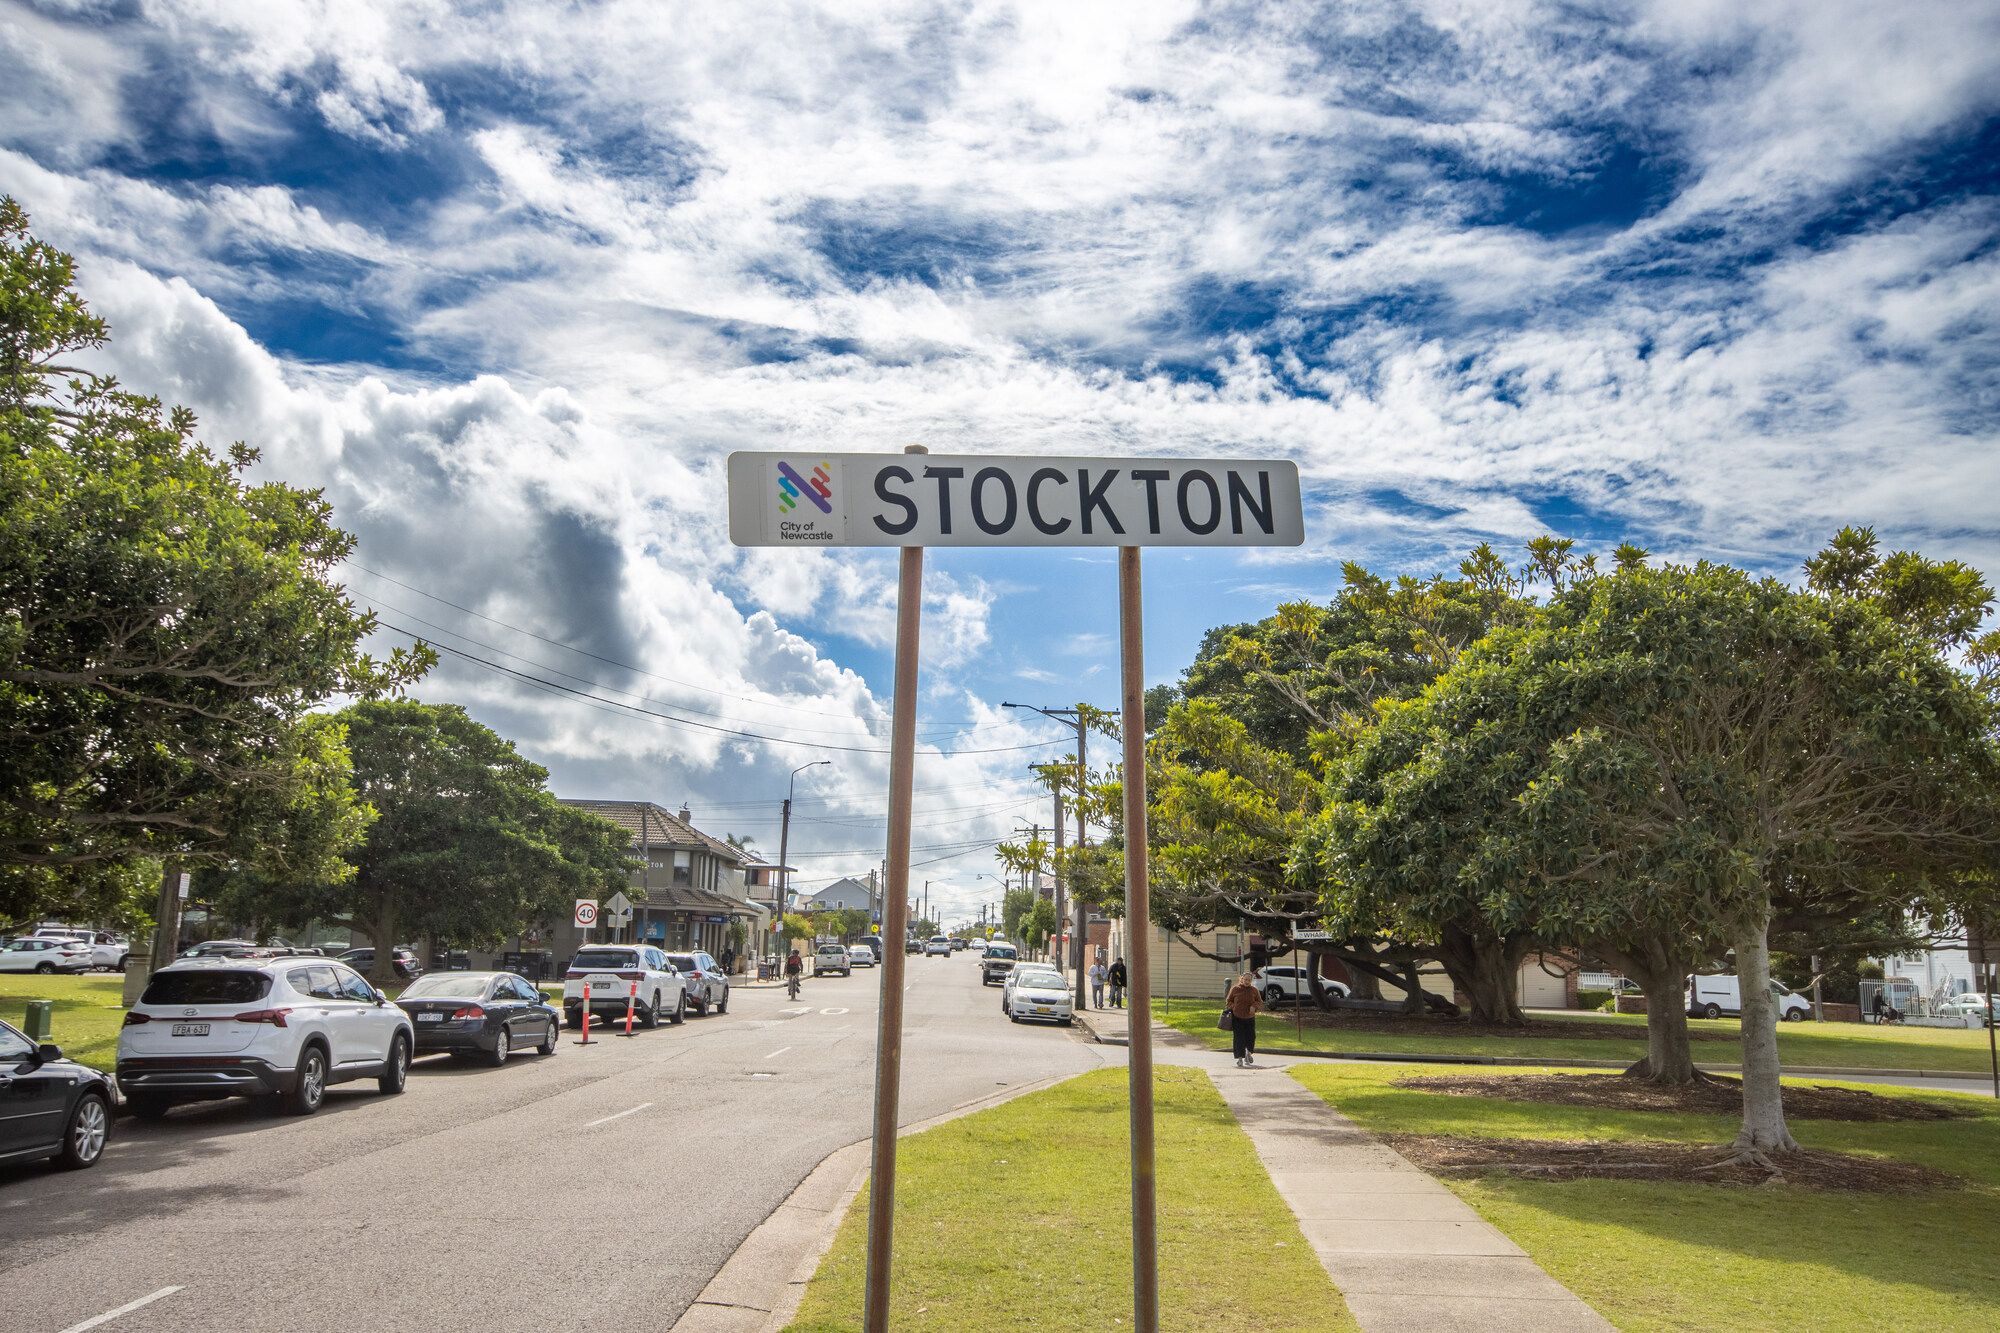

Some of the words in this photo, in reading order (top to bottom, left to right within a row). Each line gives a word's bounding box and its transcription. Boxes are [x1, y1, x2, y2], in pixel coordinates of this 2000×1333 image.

[872, 465, 1274, 536] STOCKTON
[780, 521, 801, 532] City
[803, 521, 814, 531] of
[780, 530, 833, 540] Newcastle
[579, 908, 594, 919] 40
